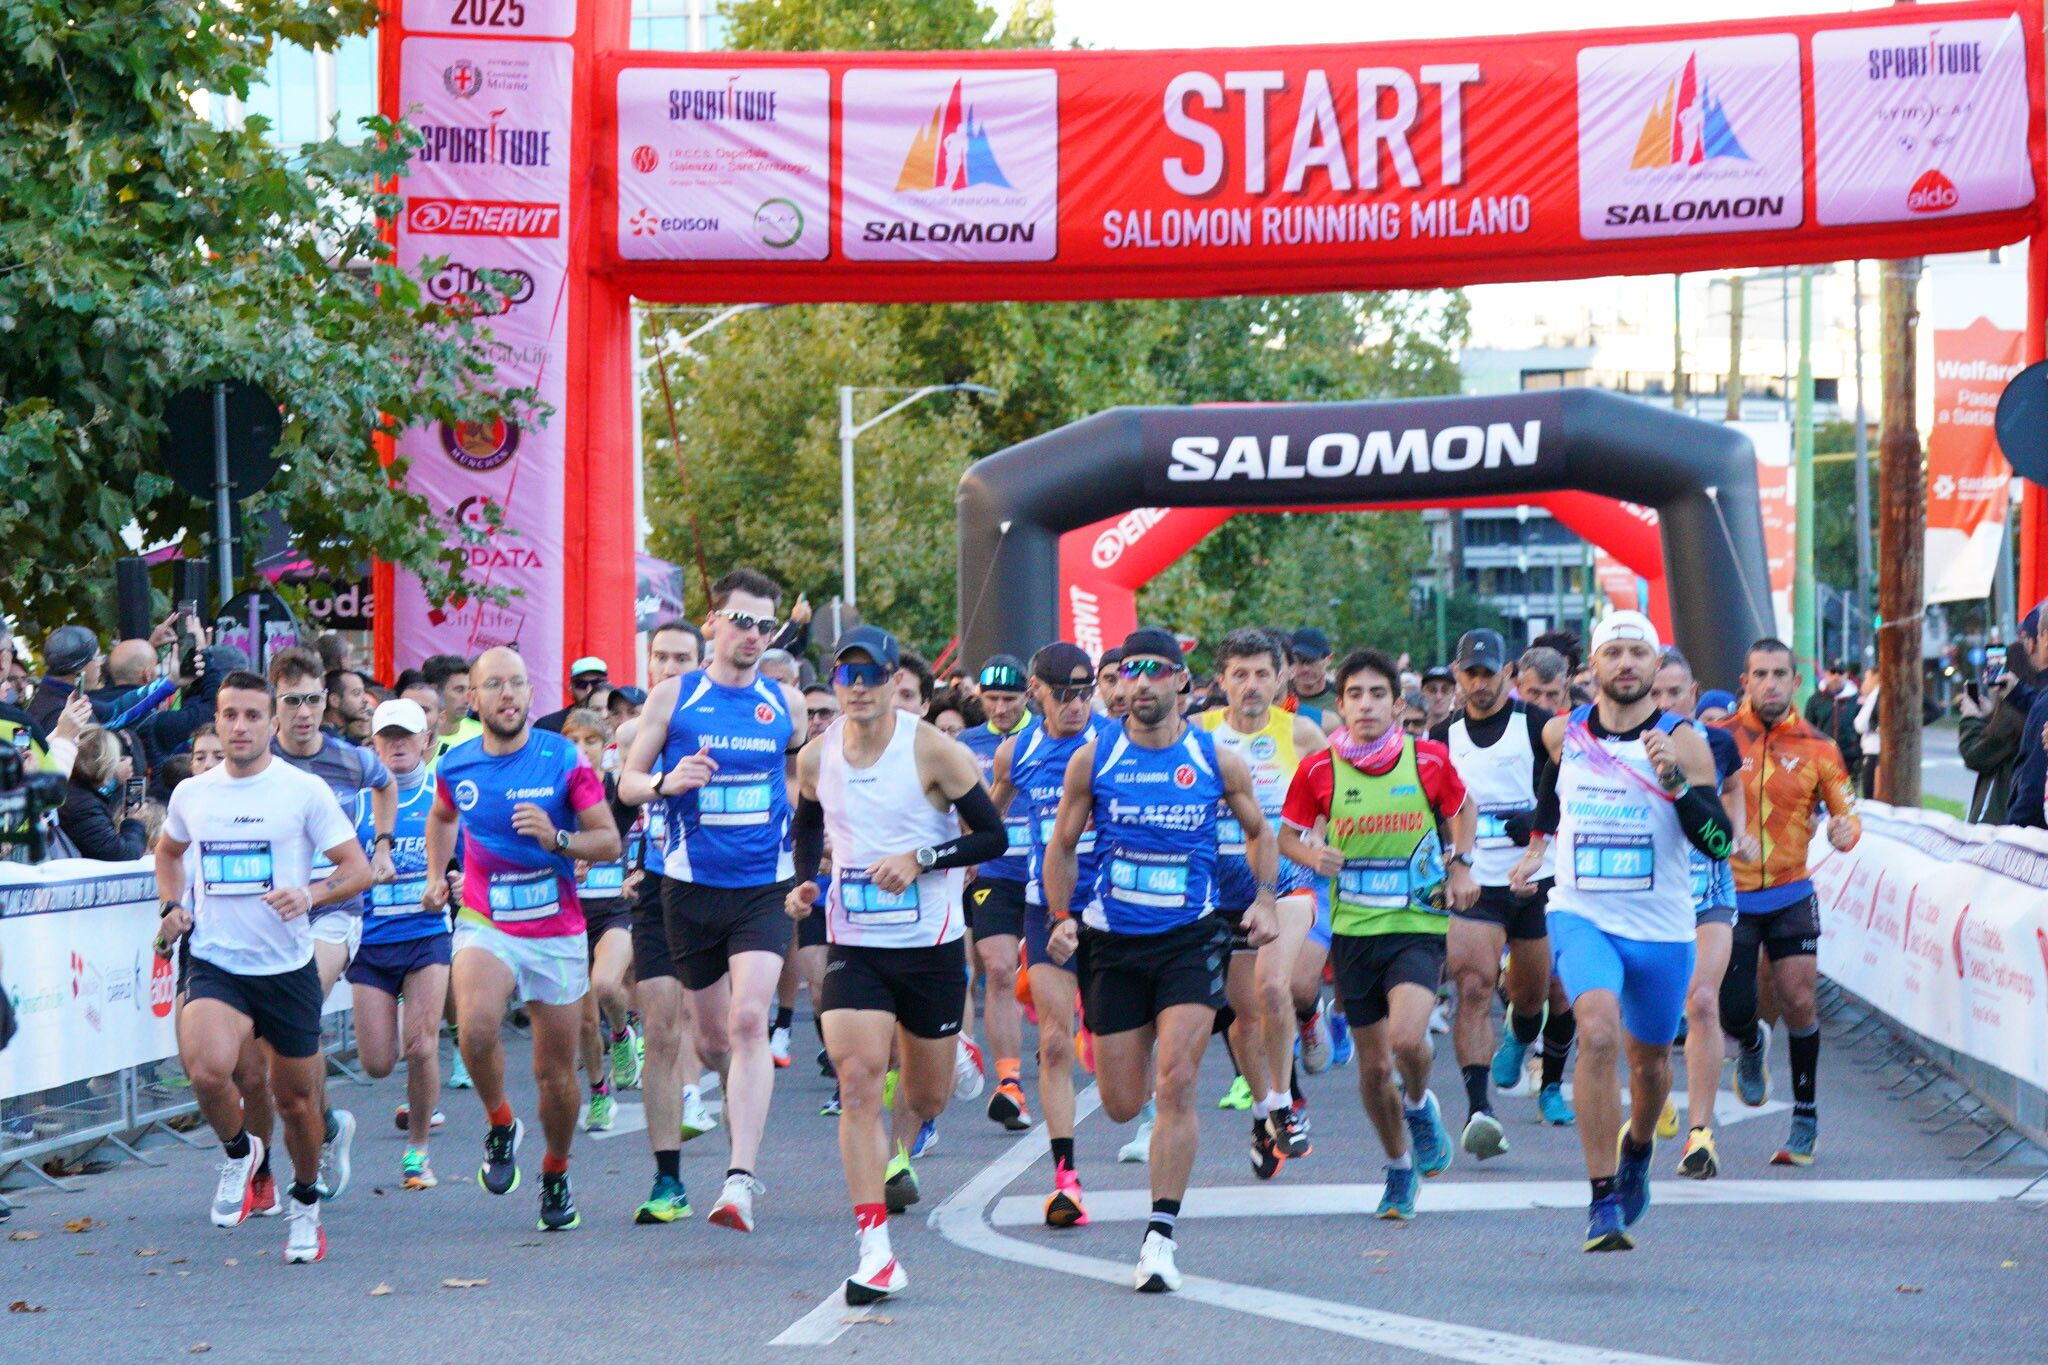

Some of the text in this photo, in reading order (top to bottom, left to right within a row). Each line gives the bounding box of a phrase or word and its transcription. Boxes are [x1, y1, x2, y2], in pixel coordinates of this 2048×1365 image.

[451, 0, 525, 27] 2025
[1162, 63, 1480, 195] START
[452, 204, 558, 233] ENERVIT
[1103, 194, 1530, 248] SALOMON RUNNING MILANO
[1605, 196, 1784, 227] SALOMON
[863, 222, 1035, 243] SALOMON
[1167, 419, 1541, 482] SALOMON
